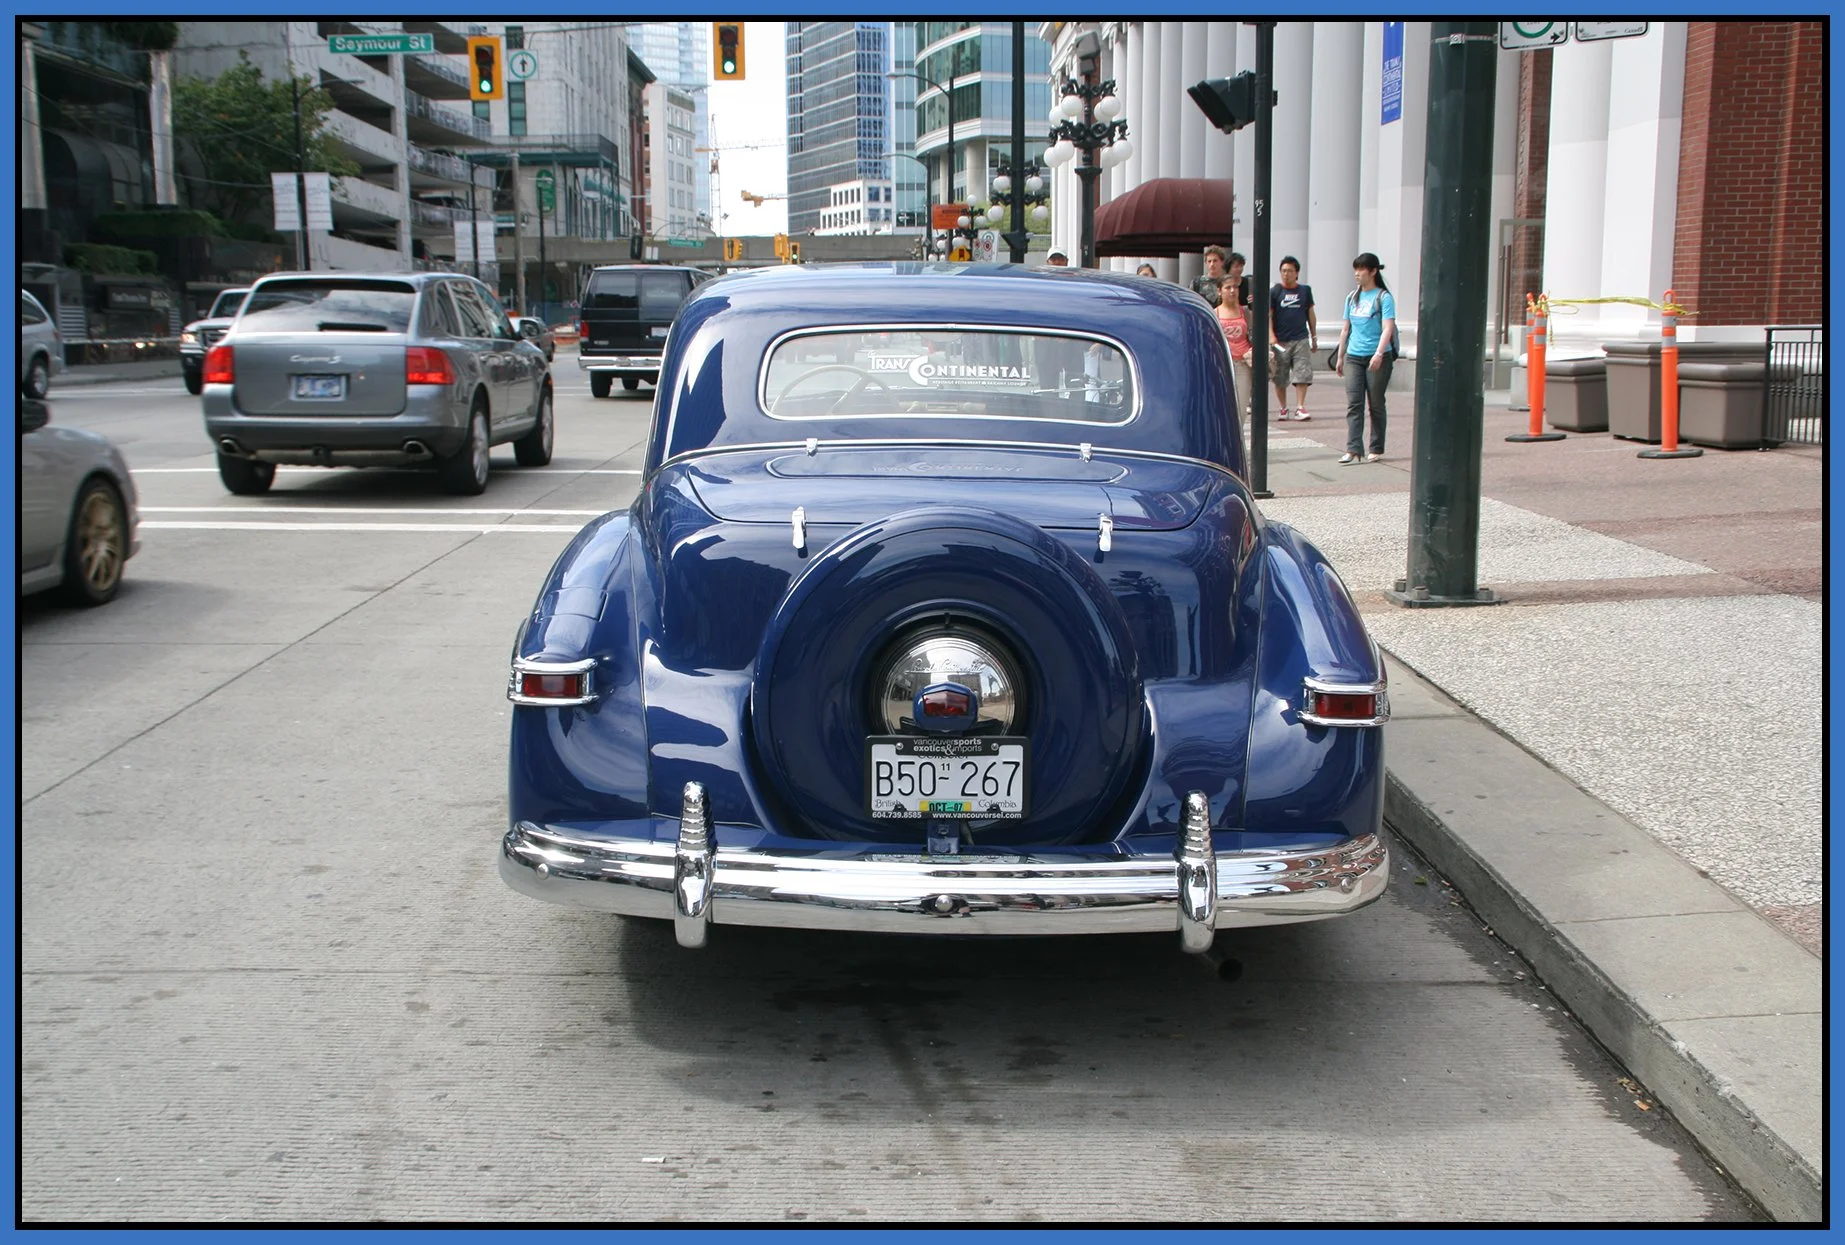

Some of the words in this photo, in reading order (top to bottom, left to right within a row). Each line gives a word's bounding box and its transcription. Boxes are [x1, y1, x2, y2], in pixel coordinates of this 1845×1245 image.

[335, 36, 401, 52] Seymour
[408, 35, 427, 49] St
[978, 799, 1017, 808] Colmbia
[872, 811, 922, 819] 604.739.8585
